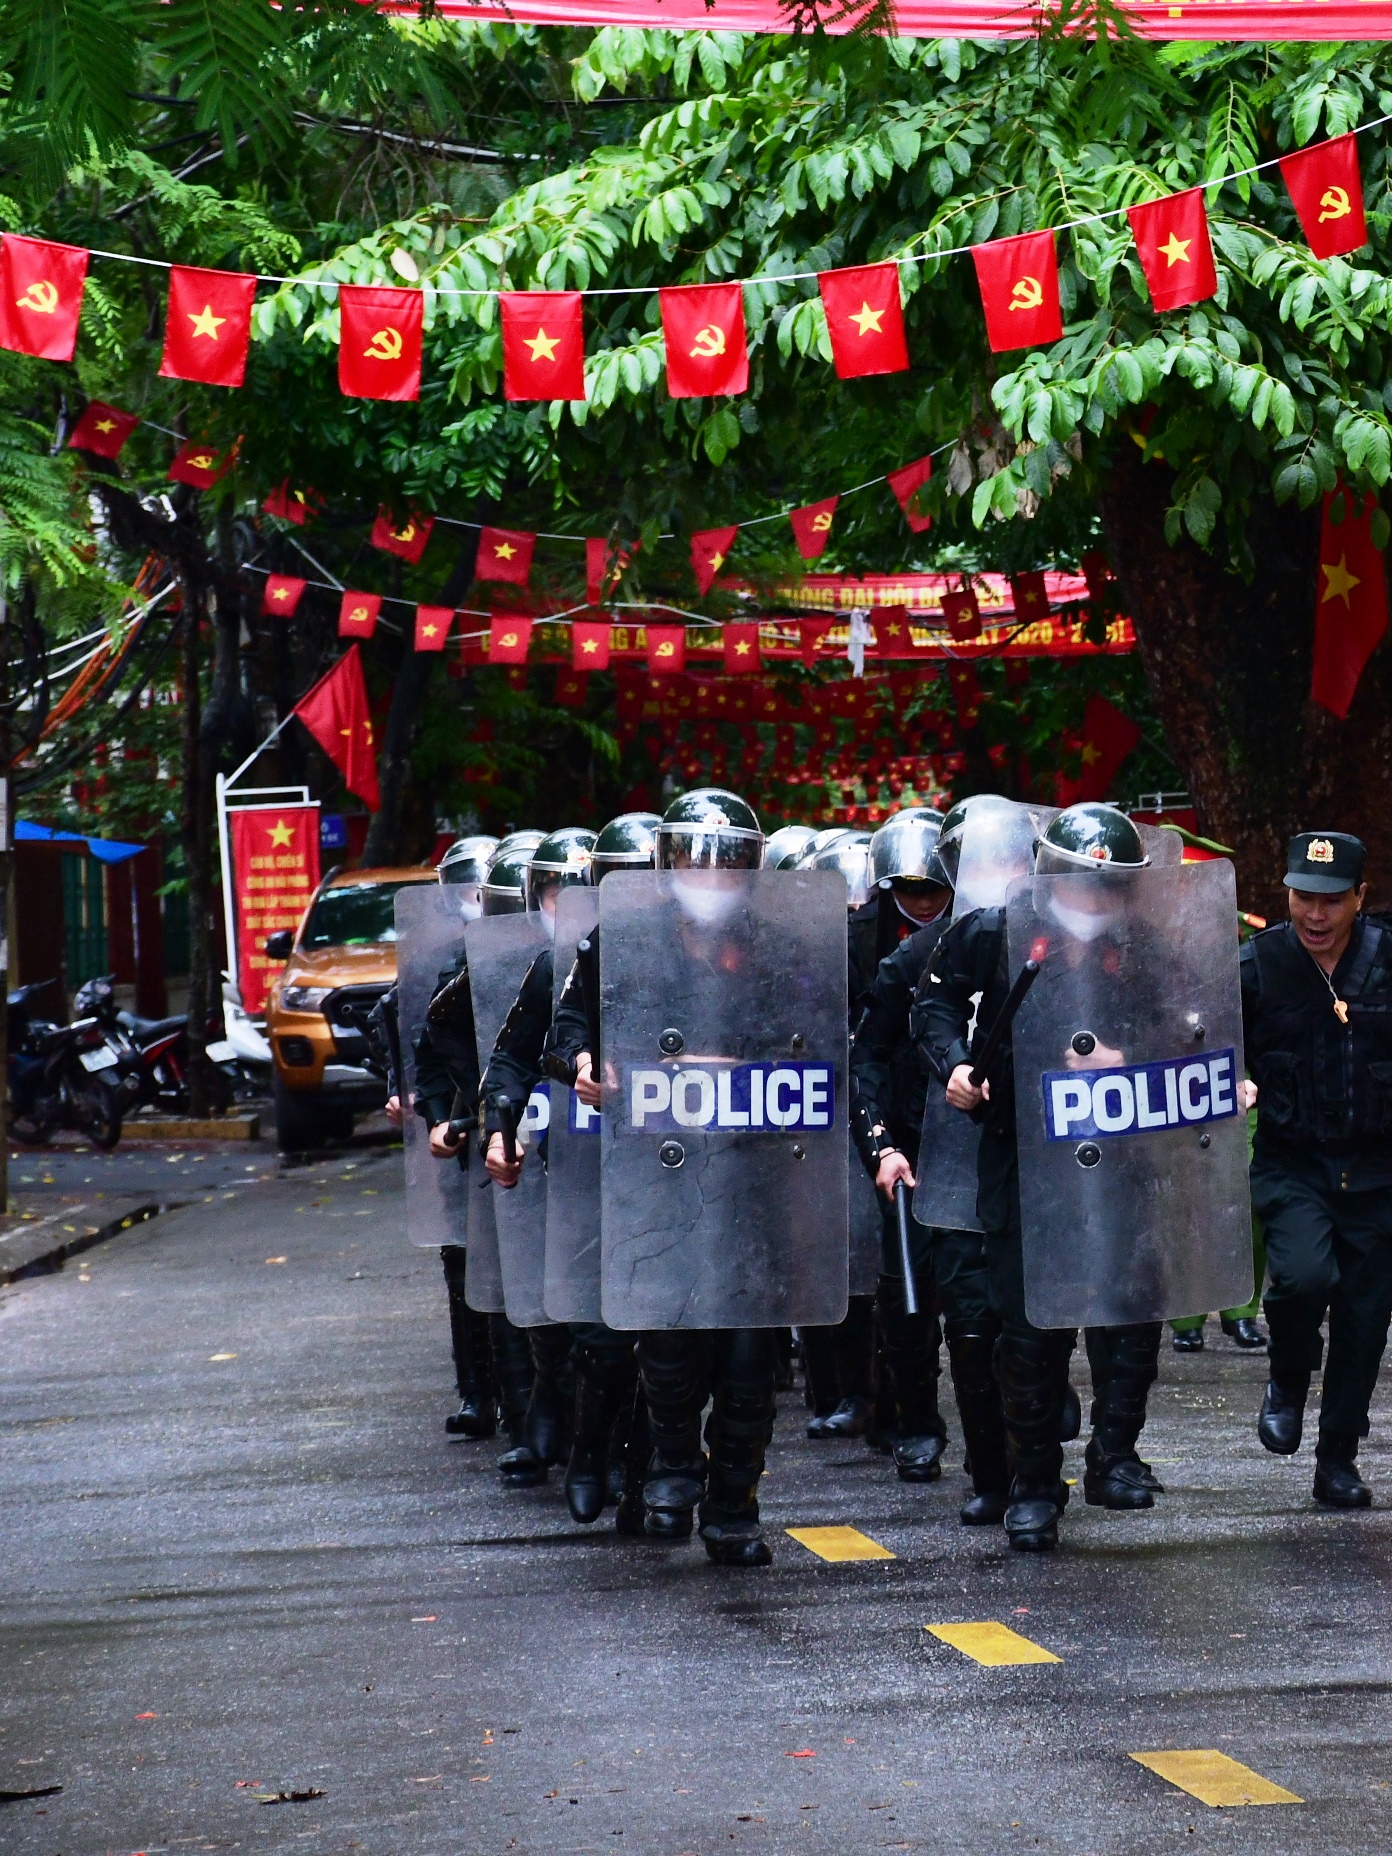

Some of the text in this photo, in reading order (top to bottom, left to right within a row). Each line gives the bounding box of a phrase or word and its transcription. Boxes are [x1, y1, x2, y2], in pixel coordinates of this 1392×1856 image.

[1071, 620, 1125, 643] 25!
[631, 1068, 829, 1127] POLICE
[1051, 1057, 1233, 1137] POLICE
